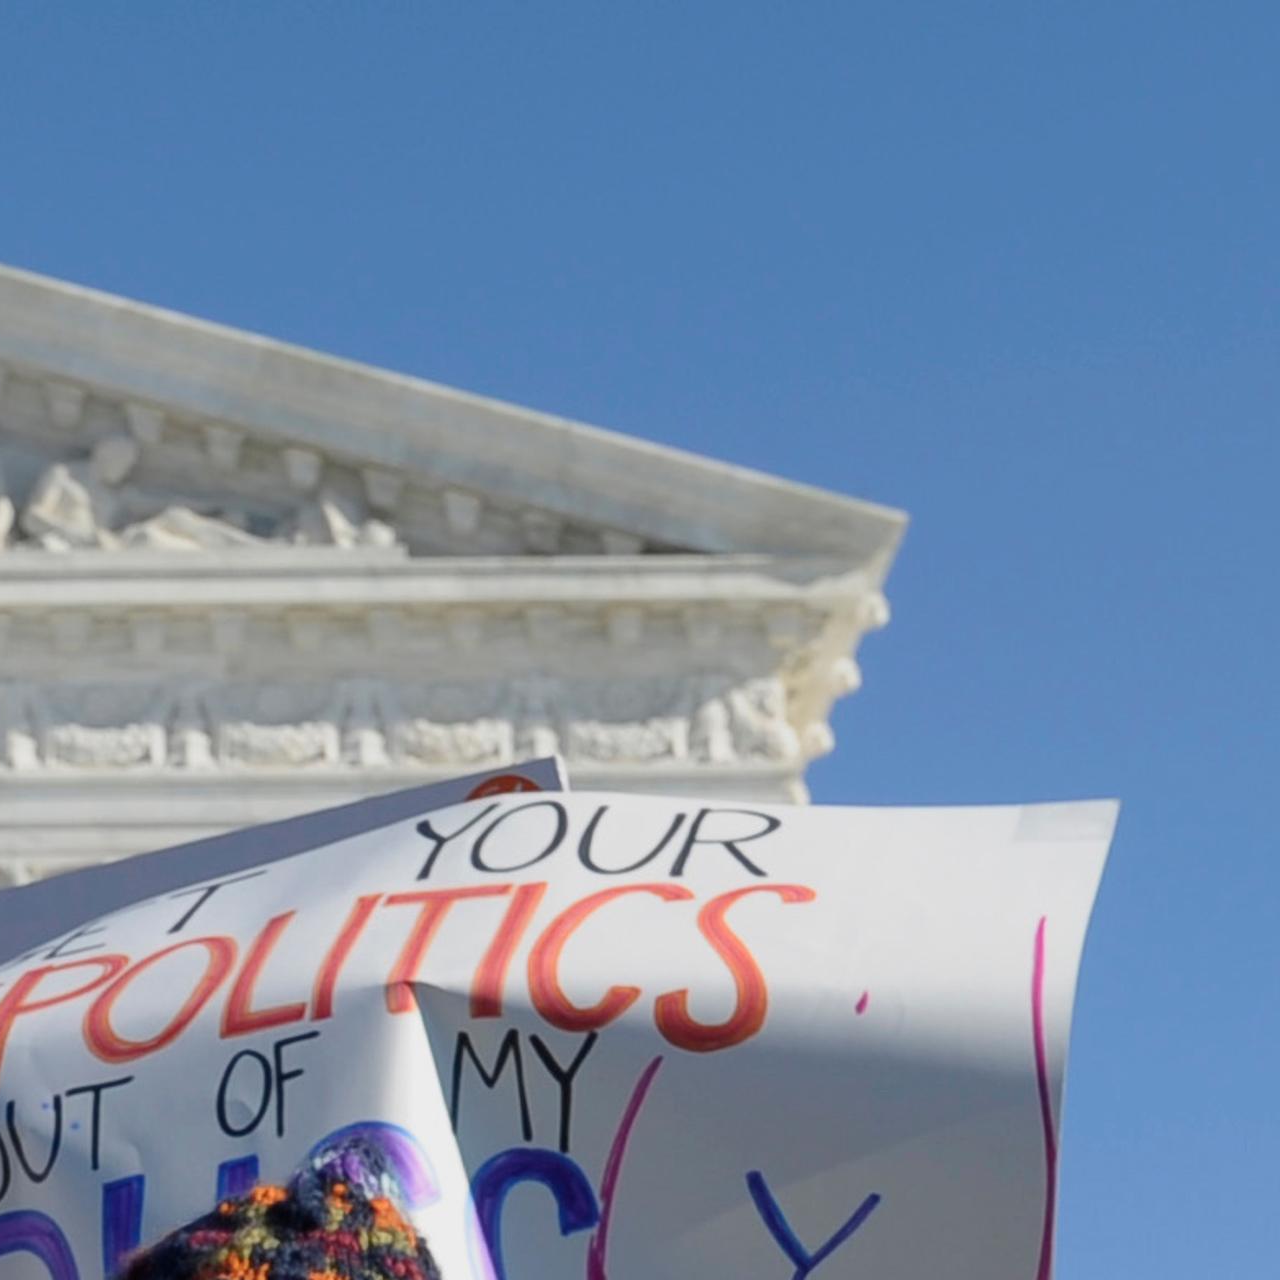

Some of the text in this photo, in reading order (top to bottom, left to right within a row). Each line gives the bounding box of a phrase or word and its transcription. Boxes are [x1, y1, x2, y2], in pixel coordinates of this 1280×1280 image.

[13, 799, 782, 968] ET YOUR
[215, 1031, 320, 1138] OF
[451, 1029, 599, 1152] MY
